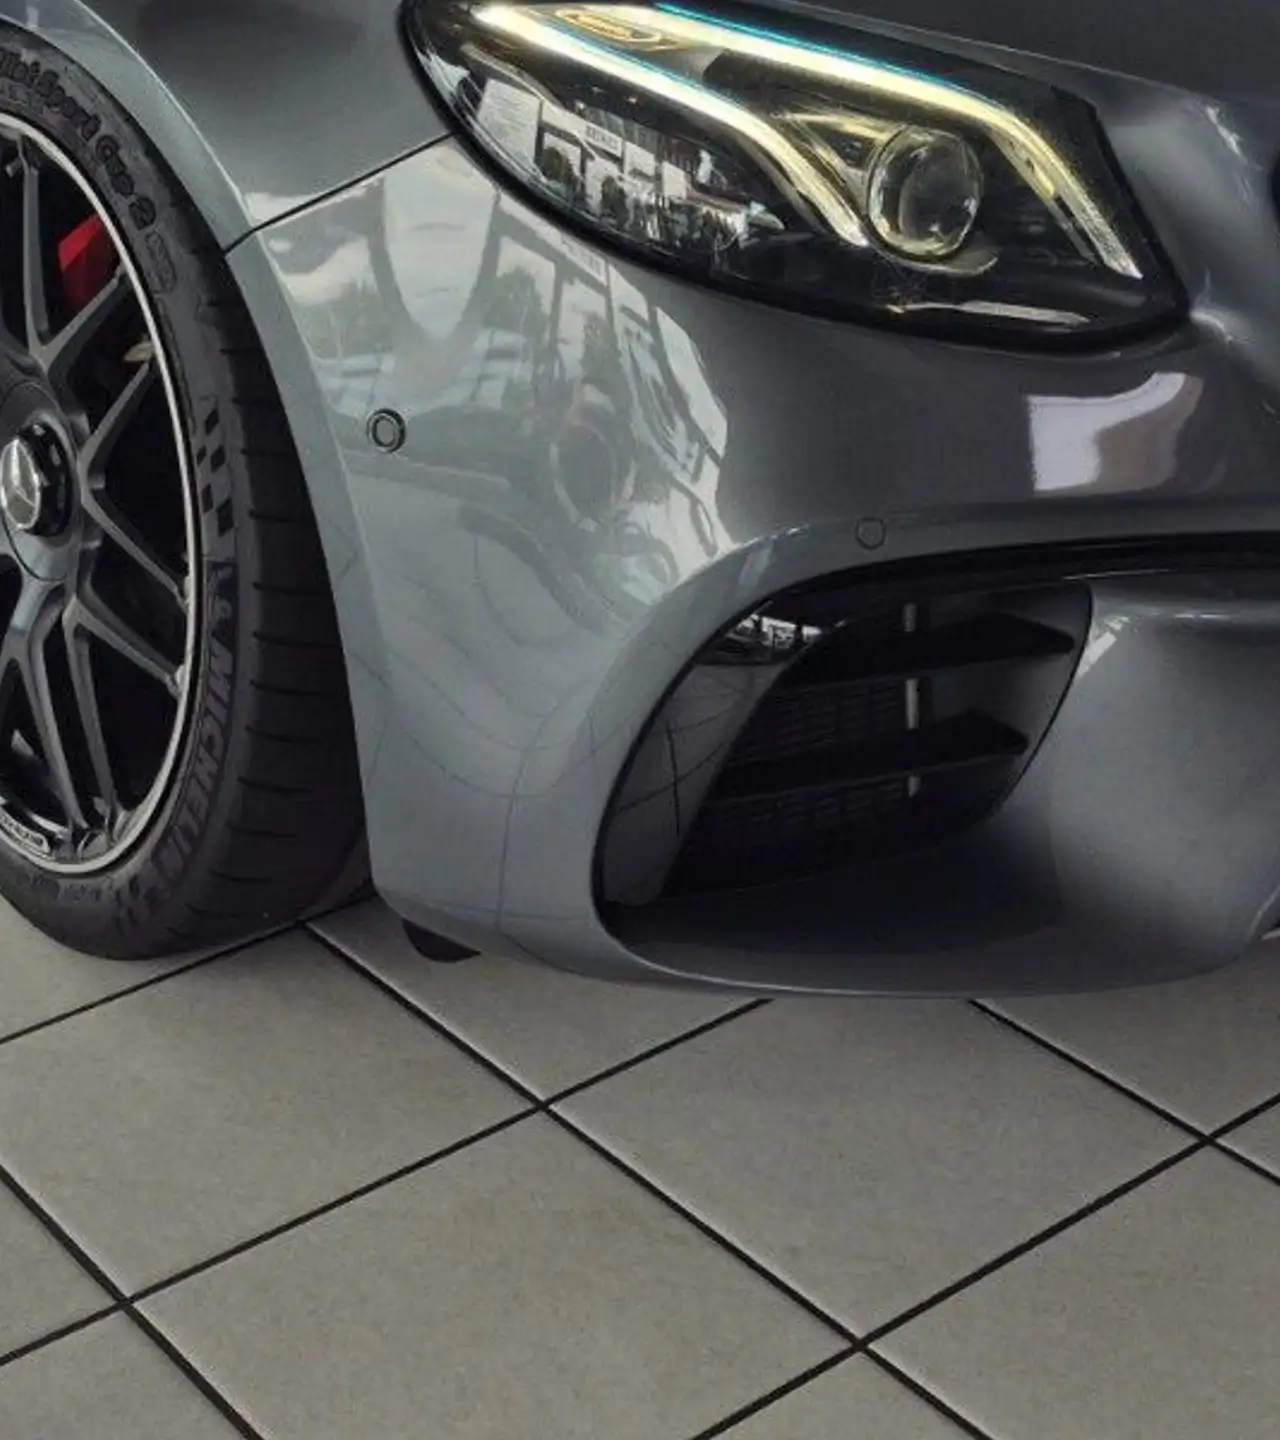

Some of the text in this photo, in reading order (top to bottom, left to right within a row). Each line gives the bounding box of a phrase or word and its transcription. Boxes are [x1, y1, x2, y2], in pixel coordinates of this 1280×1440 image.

[94, 134, 135, 198] Cup
[129, 197, 156, 231] 2
[152, 635, 235, 888] MICHELIN
